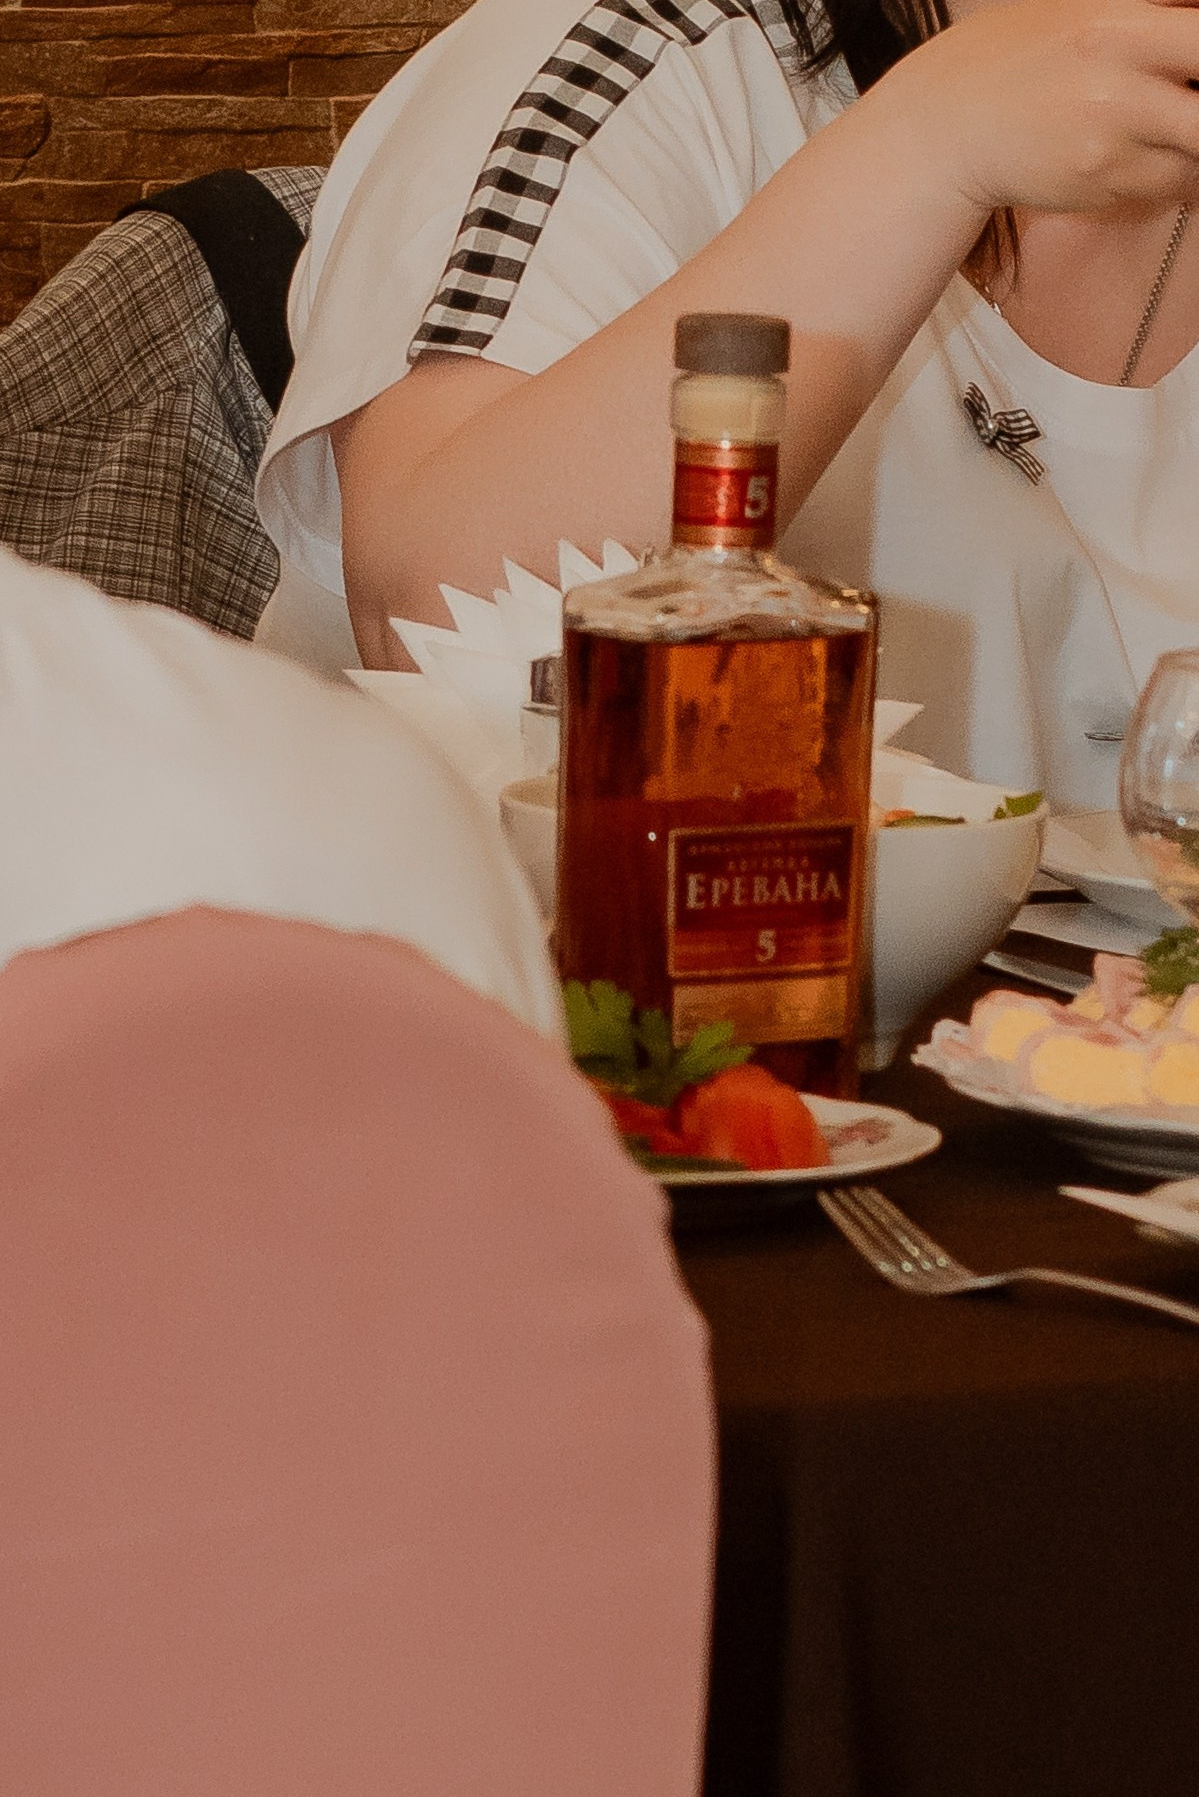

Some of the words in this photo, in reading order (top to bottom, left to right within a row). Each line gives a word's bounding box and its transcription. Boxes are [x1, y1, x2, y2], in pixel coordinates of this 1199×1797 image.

[744, 475, 769, 519] 5
[686, 871, 842, 910] ЕРЕВАНА
[755, 928, 777, 963] 5
